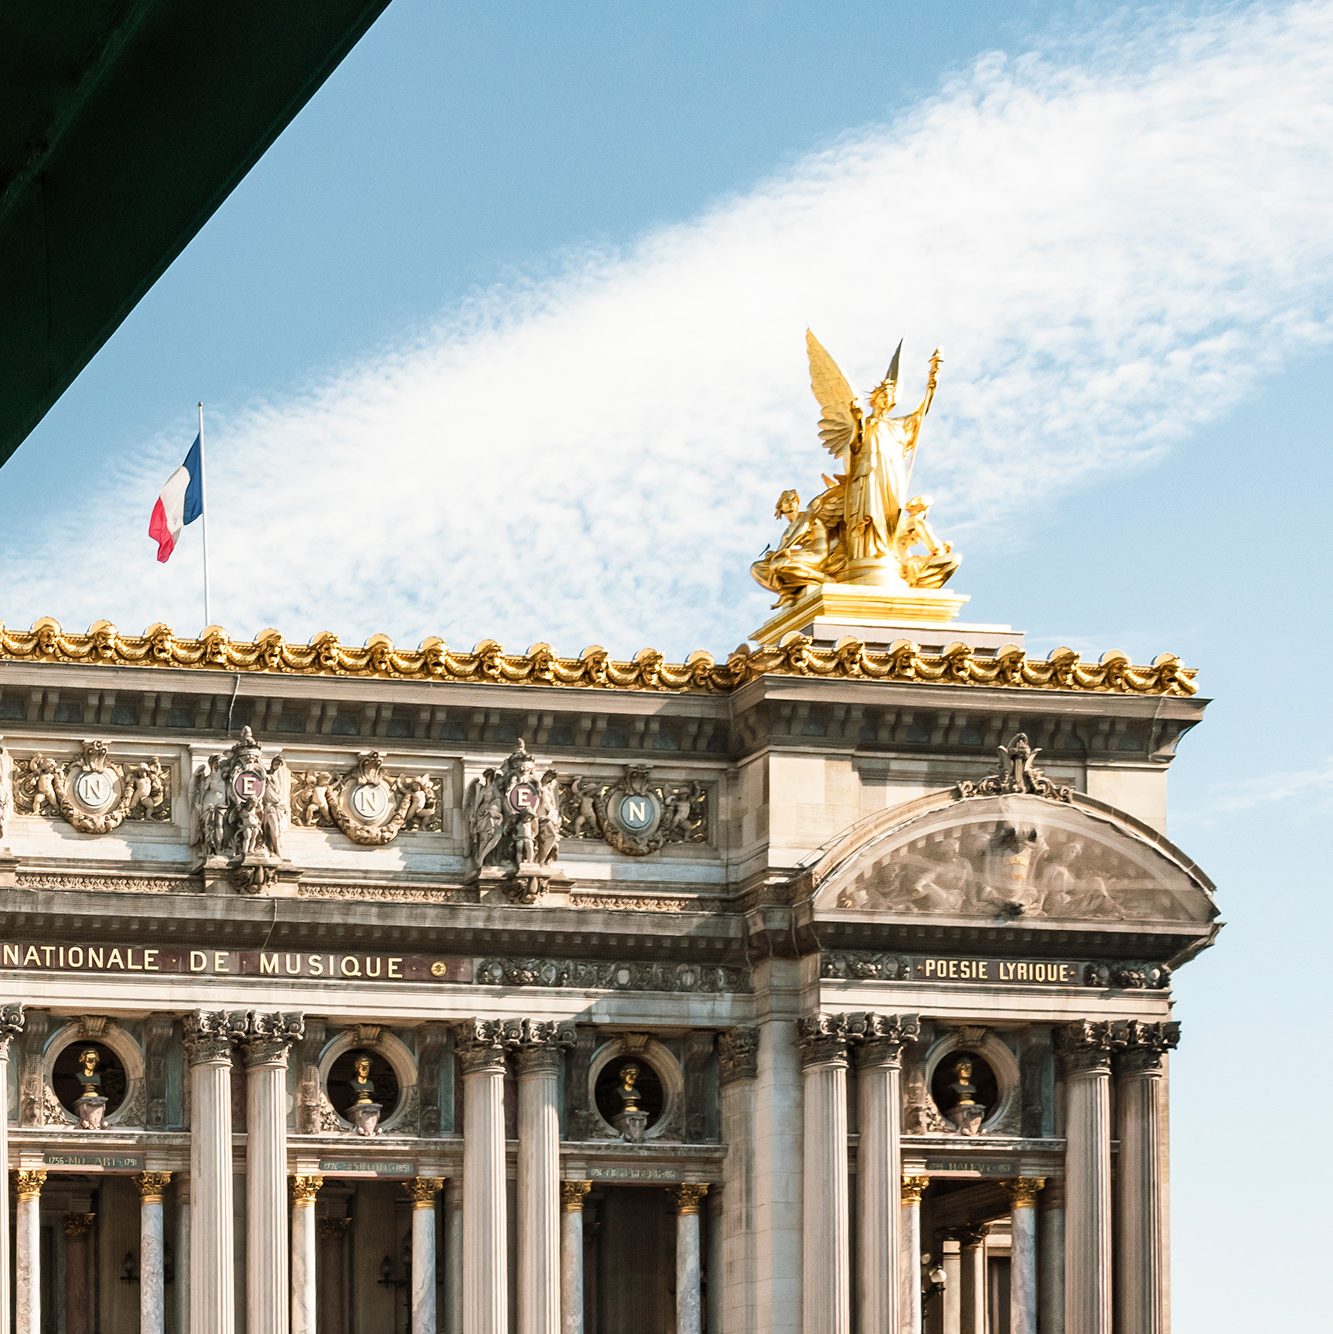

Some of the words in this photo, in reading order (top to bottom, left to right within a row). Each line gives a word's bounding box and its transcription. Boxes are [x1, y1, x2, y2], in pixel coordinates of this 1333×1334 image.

[84, 778, 101, 800] N
[242, 777, 256, 795] E
[359, 790, 377, 813] N
[517, 789, 531, 807] E
[628, 802, 645, 822] N
[2, 944, 160, 971] NATIONALE
[189, 950, 230, 973] DE
[259, 952, 403, 979] MUSIQUE
[925, 959, 988, 979] POESIE
[999, 962, 1069, 982] LYRIQUE
[48, 1156, 65, 1165] 1756
[68, 1156, 117, 1166] MOART
